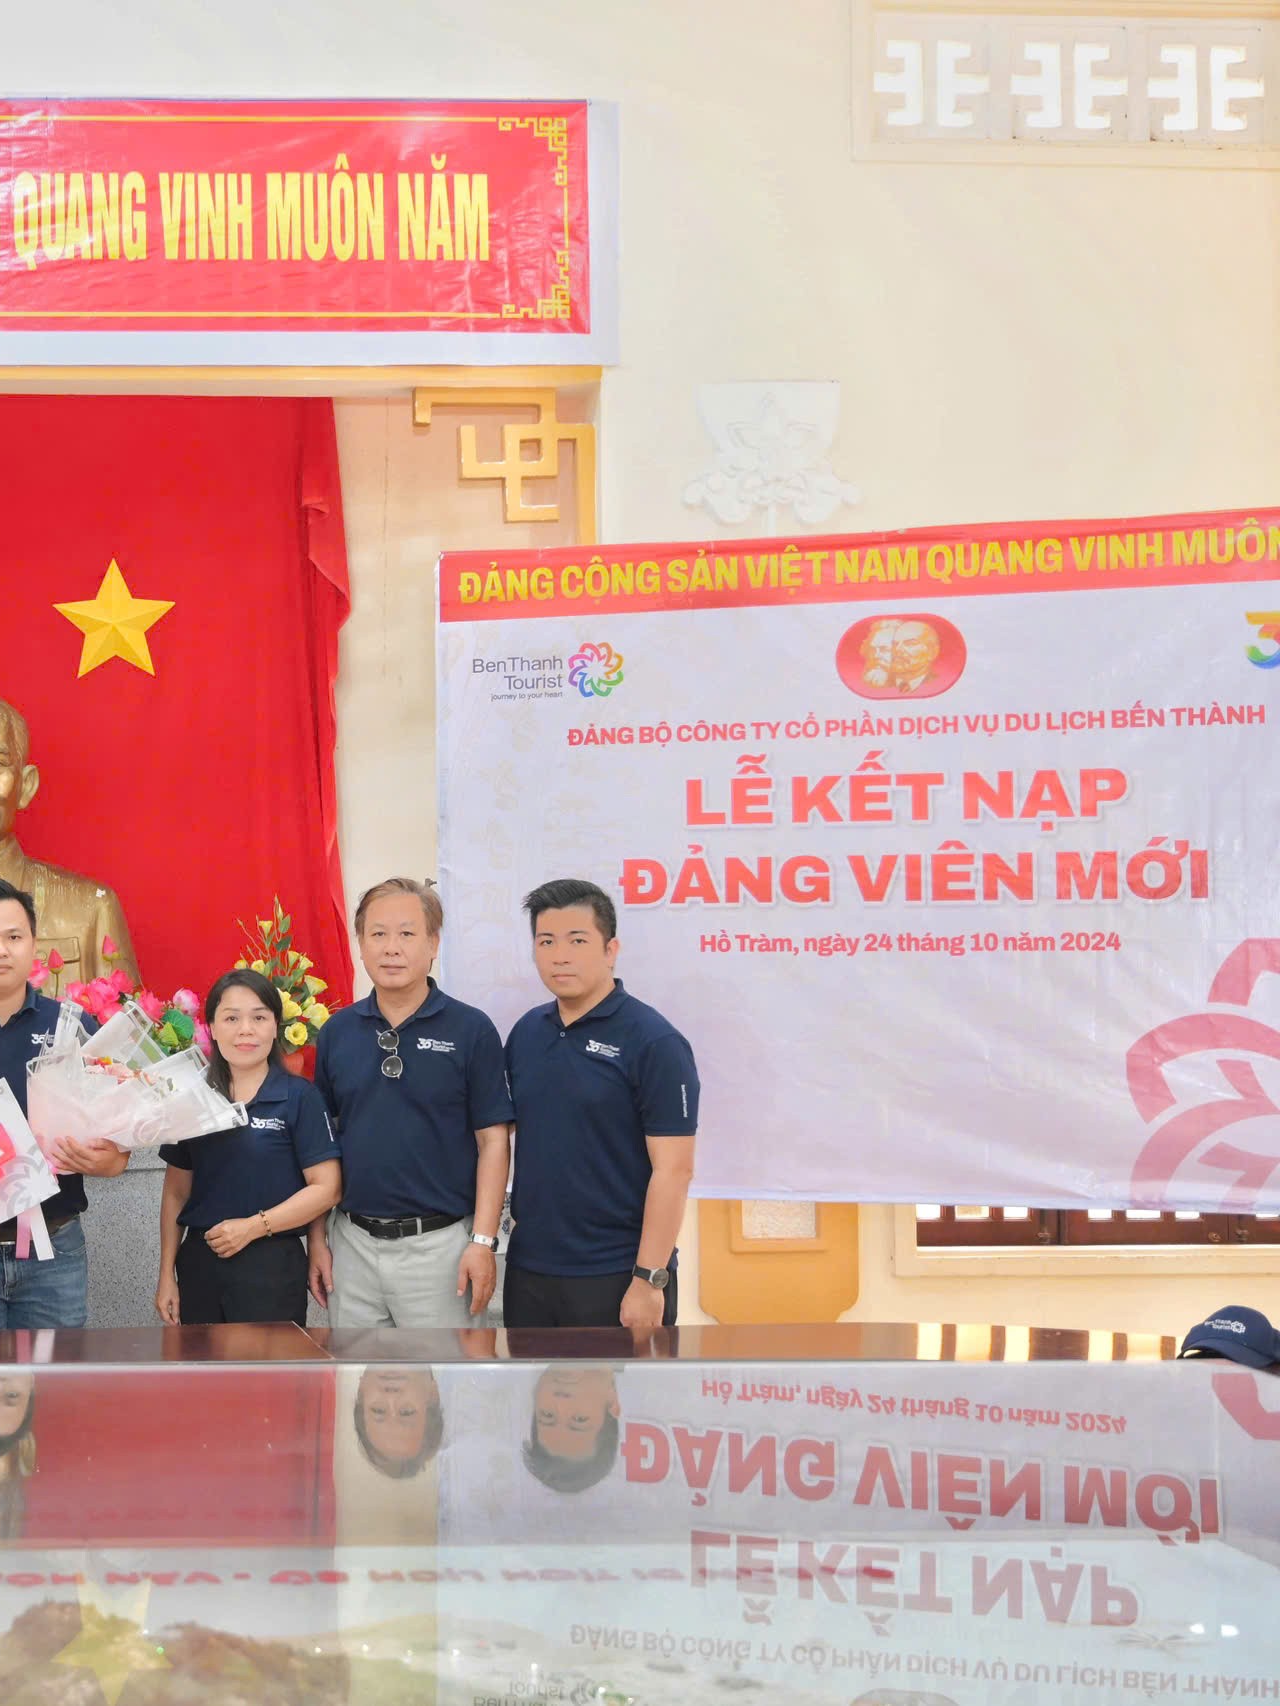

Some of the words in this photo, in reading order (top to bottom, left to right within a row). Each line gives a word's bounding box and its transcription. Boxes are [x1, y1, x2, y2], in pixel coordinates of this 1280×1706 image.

[13, 171, 147, 270] QUANG
[159, 172, 252, 260] VINH
[266, 153, 385, 261] MUÔN
[399, 154, 489, 261] NĂM
[458, 562, 555, 604] ĐẢNG
[561, 555, 661, 604] CỘNG
[667, 549, 739, 592] SẢN
[745, 544, 829, 595] VIỆT
[835, 547, 919, 583] NAM
[926, 538, 1064, 584] QUANG
[1070, 531, 1165, 571] VINH
[491, 693, 517, 702] journey
[527, 692, 543, 700] your
[504, 674, 563, 690] Tourist
[567, 722, 635, 747] ĐẢNG
[638, 720, 673, 748] BỘ
[676, 719, 747, 744] CÔNG
[750, 720, 782, 740] TY
[784, 711, 821, 740] CỔ
[824, 710, 894, 738] PHẦN
[898, 714, 959, 741] DỊCH
[962, 713, 1000, 737] VỤ
[1004, 712, 1041, 733] DU
[1046, 708, 1106, 736] LỊCH
[1110, 700, 1166, 729] BẾN
[1170, 701, 1266, 727] THÀNH
[686, 753, 774, 826] LỄ
[791, 750, 945, 824] KẾT
[963, 768, 1127, 831] NẠP
[618, 843, 831, 905] ĐẢNG
[848, 840, 1034, 903] VIÊN
[1056, 836, 1209, 901] MỚI
[699, 929, 732, 953] Hồ
[736, 933, 800, 956] Tràm,
[803, 933, 860, 957] ngày
[864, 933, 894, 953] 24
[896, 932, 966, 957] tháng
[970, 931, 999, 952] 10
[1003, 931, 1057, 952] năm
[1060, 931, 1122, 952] 2024
